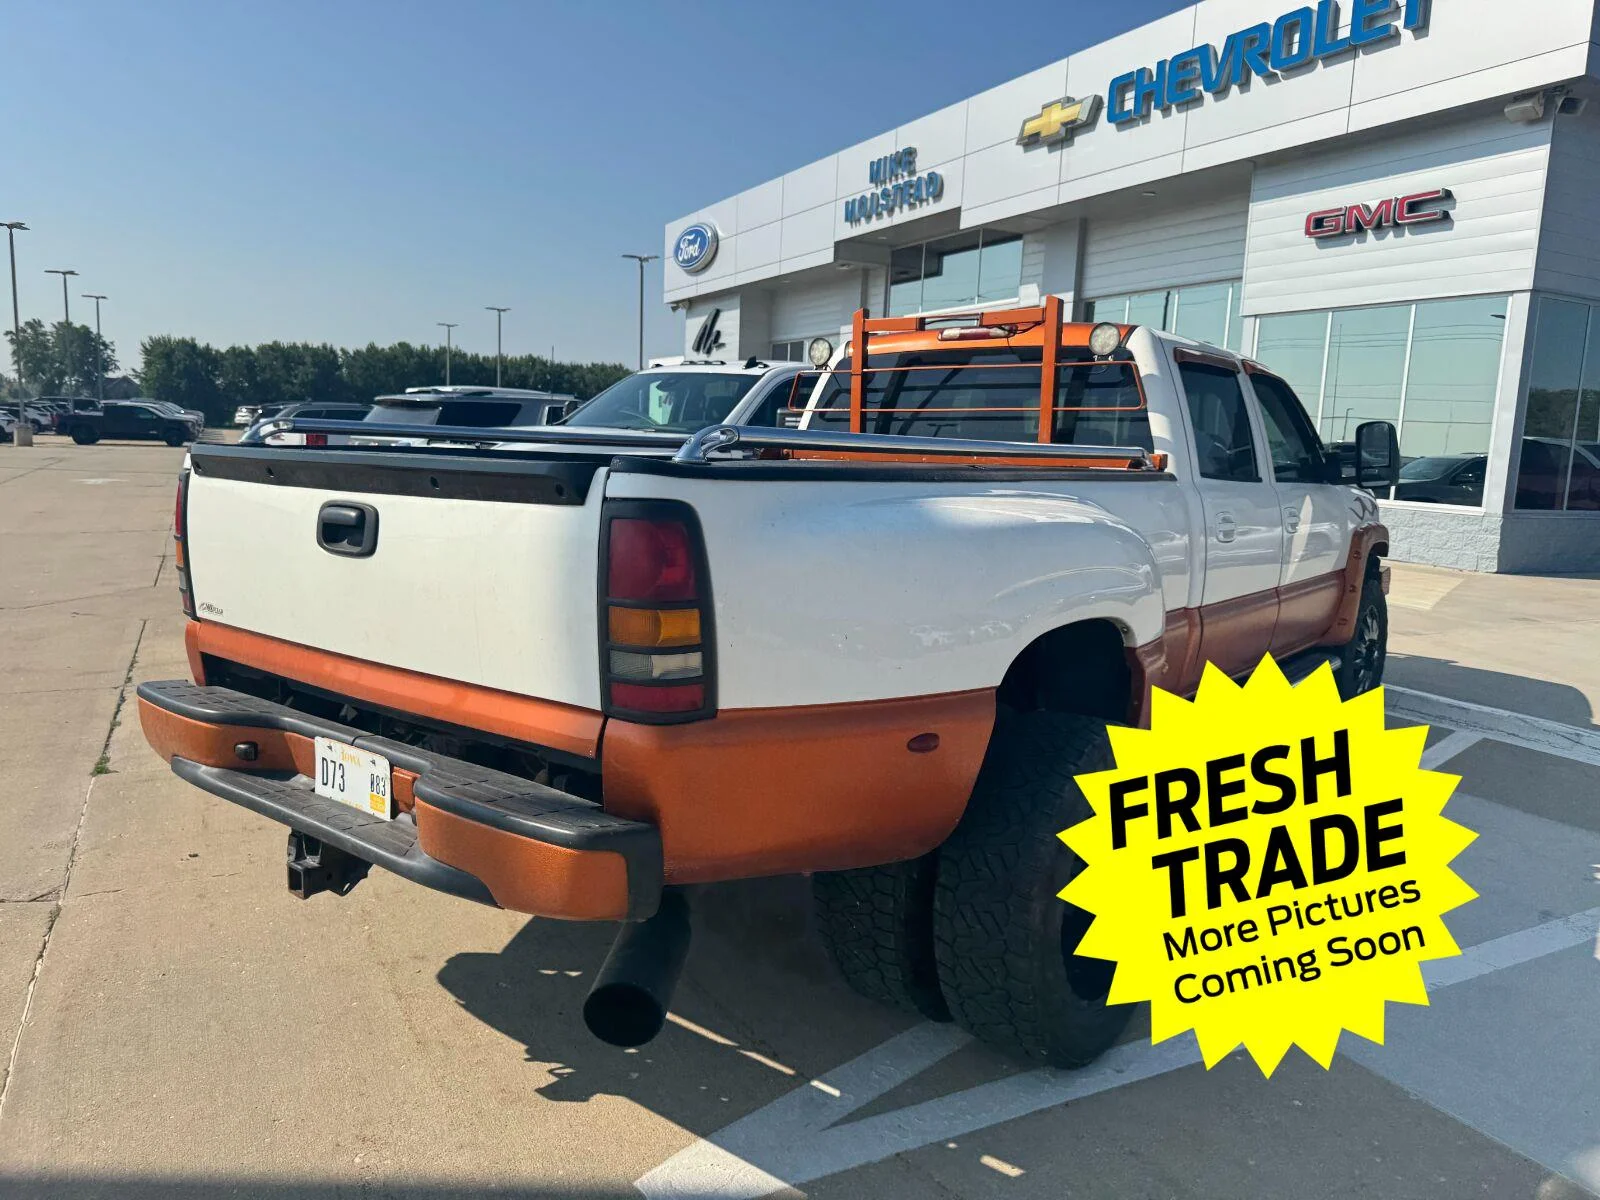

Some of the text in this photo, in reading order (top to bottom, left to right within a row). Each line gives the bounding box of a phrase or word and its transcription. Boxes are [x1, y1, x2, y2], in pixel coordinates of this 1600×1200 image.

[869, 147, 917, 187] MIKE
[1305, 188, 1448, 239] GMC
[678, 233, 701, 261] Ford
[321, 756, 345, 792] D73
